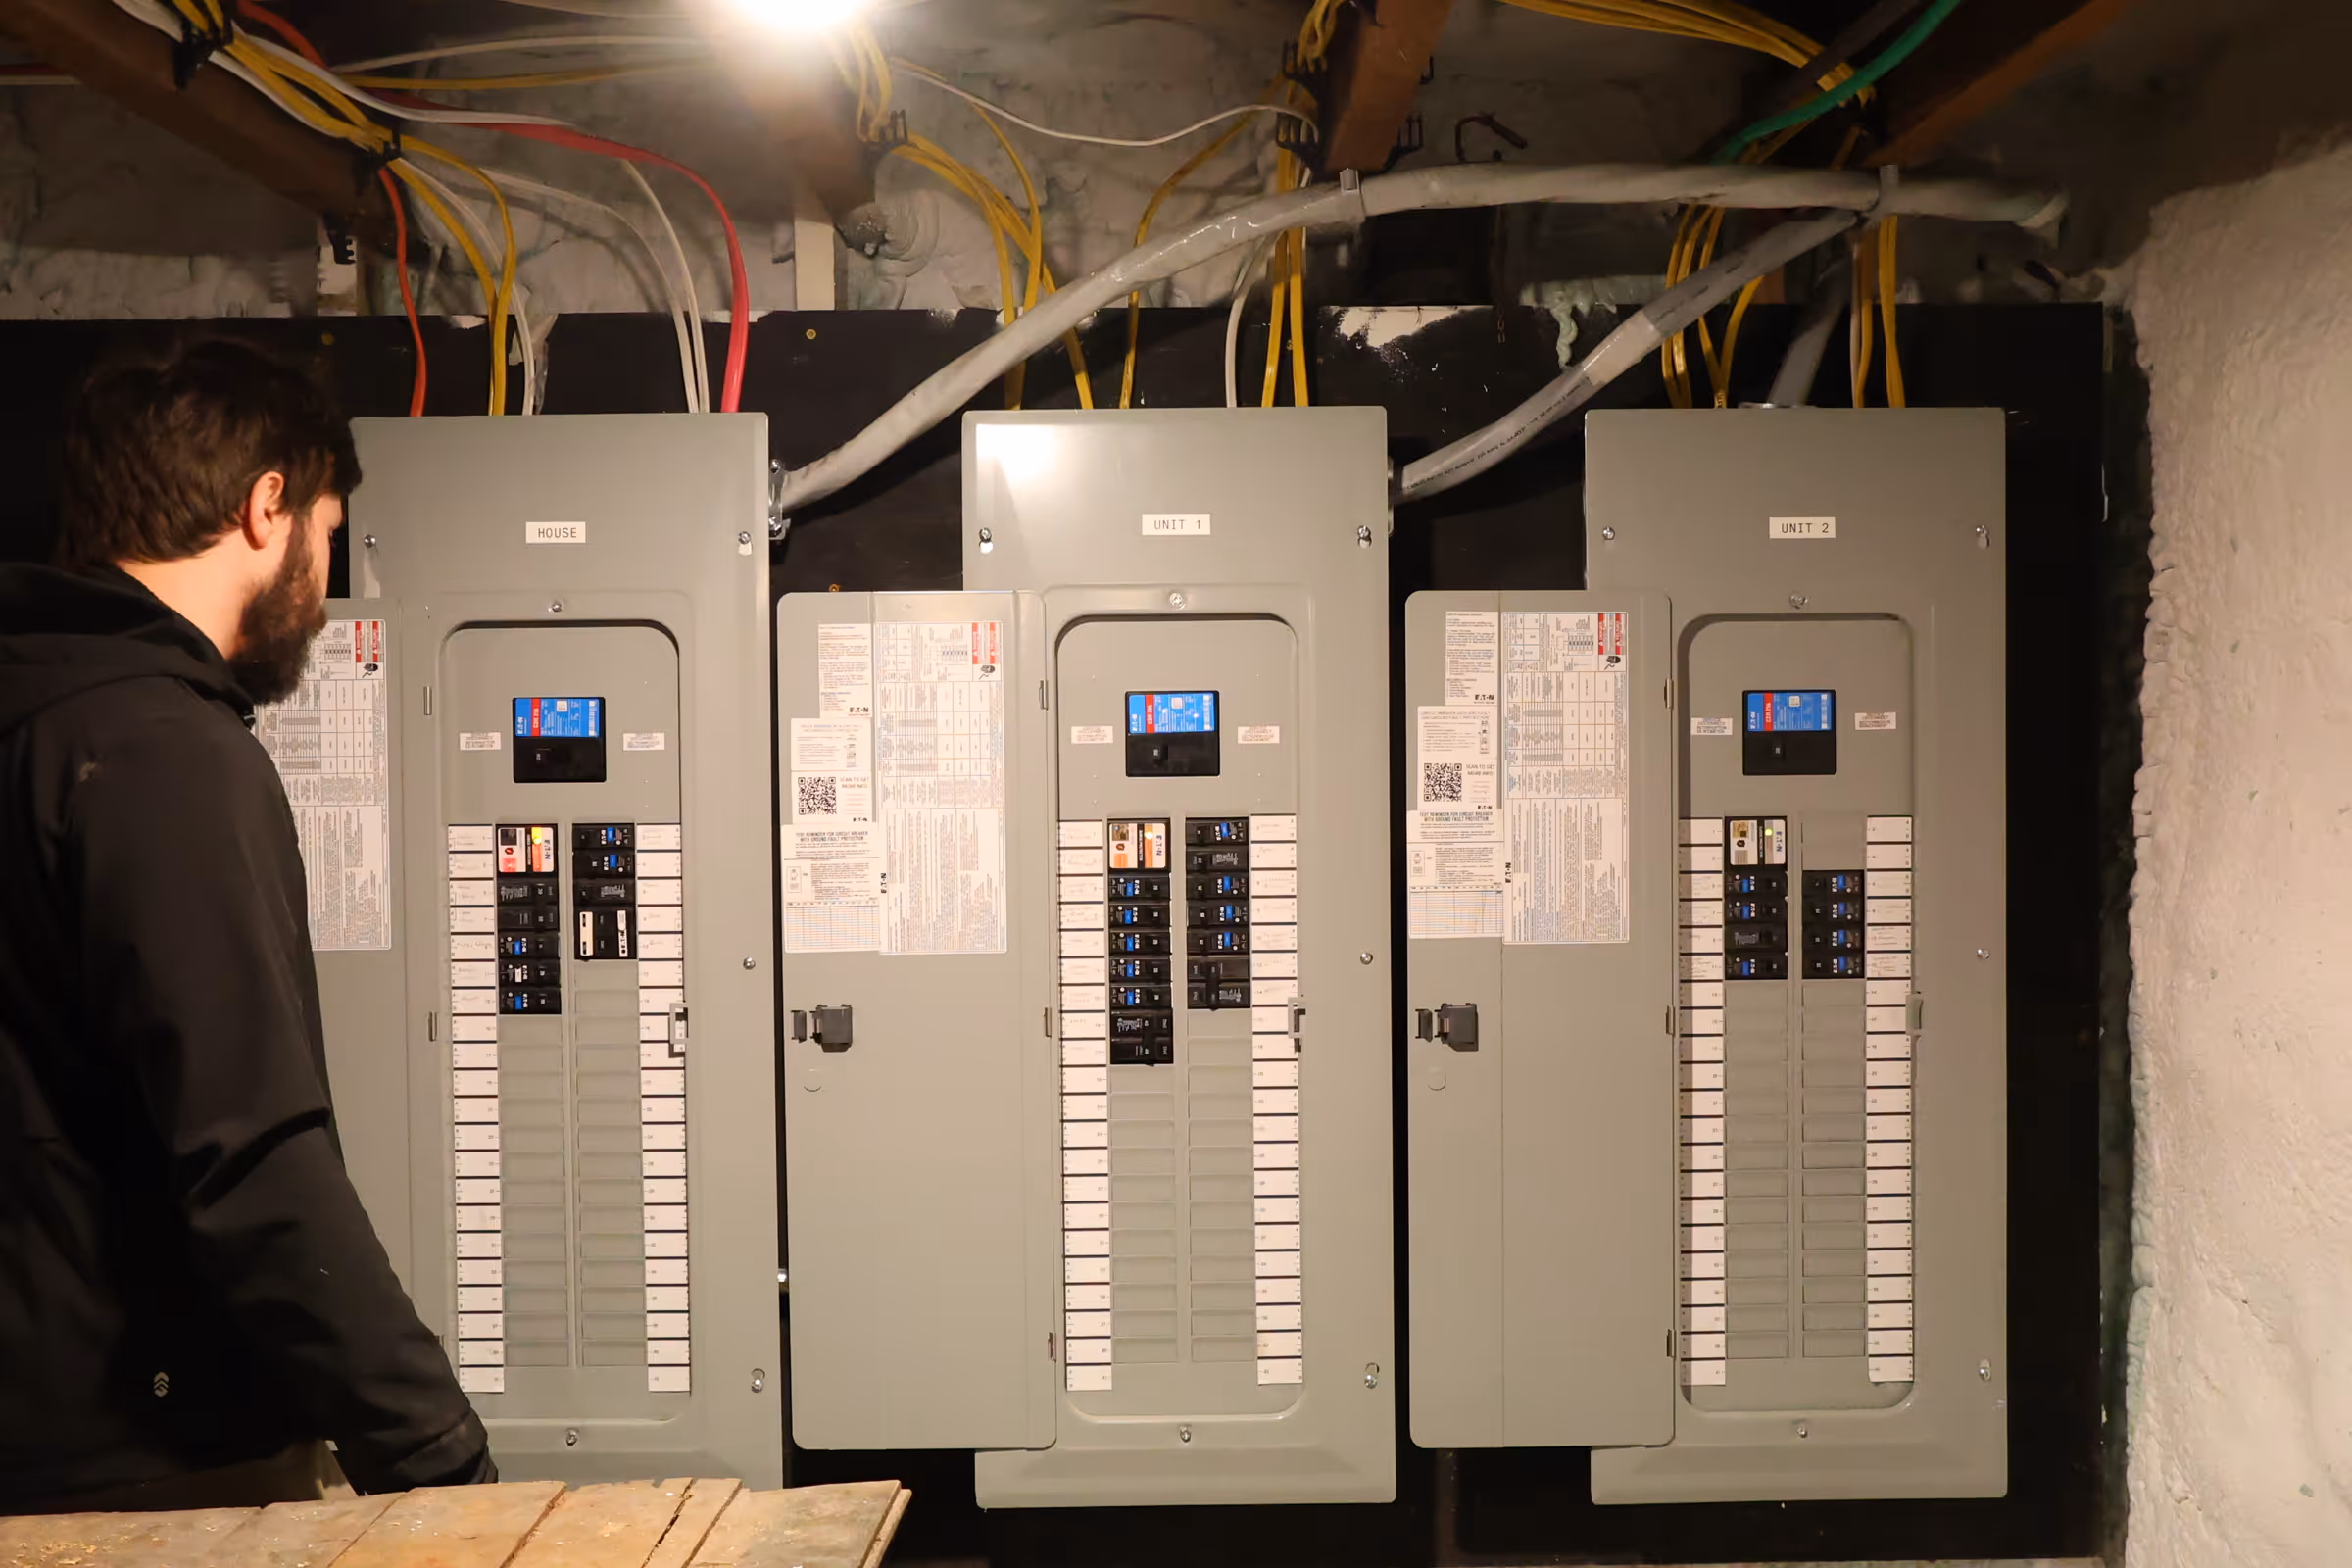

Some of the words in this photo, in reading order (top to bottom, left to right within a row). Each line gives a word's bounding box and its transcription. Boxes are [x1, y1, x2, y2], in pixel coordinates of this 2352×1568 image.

[1154, 520, 1185, 530] UNIT
[1196, 519, 1201, 530] 1
[1781, 522, 1813, 534] UNIT
[1822, 522, 1829, 534] 2
[537, 526, 577, 538] HOUSE
